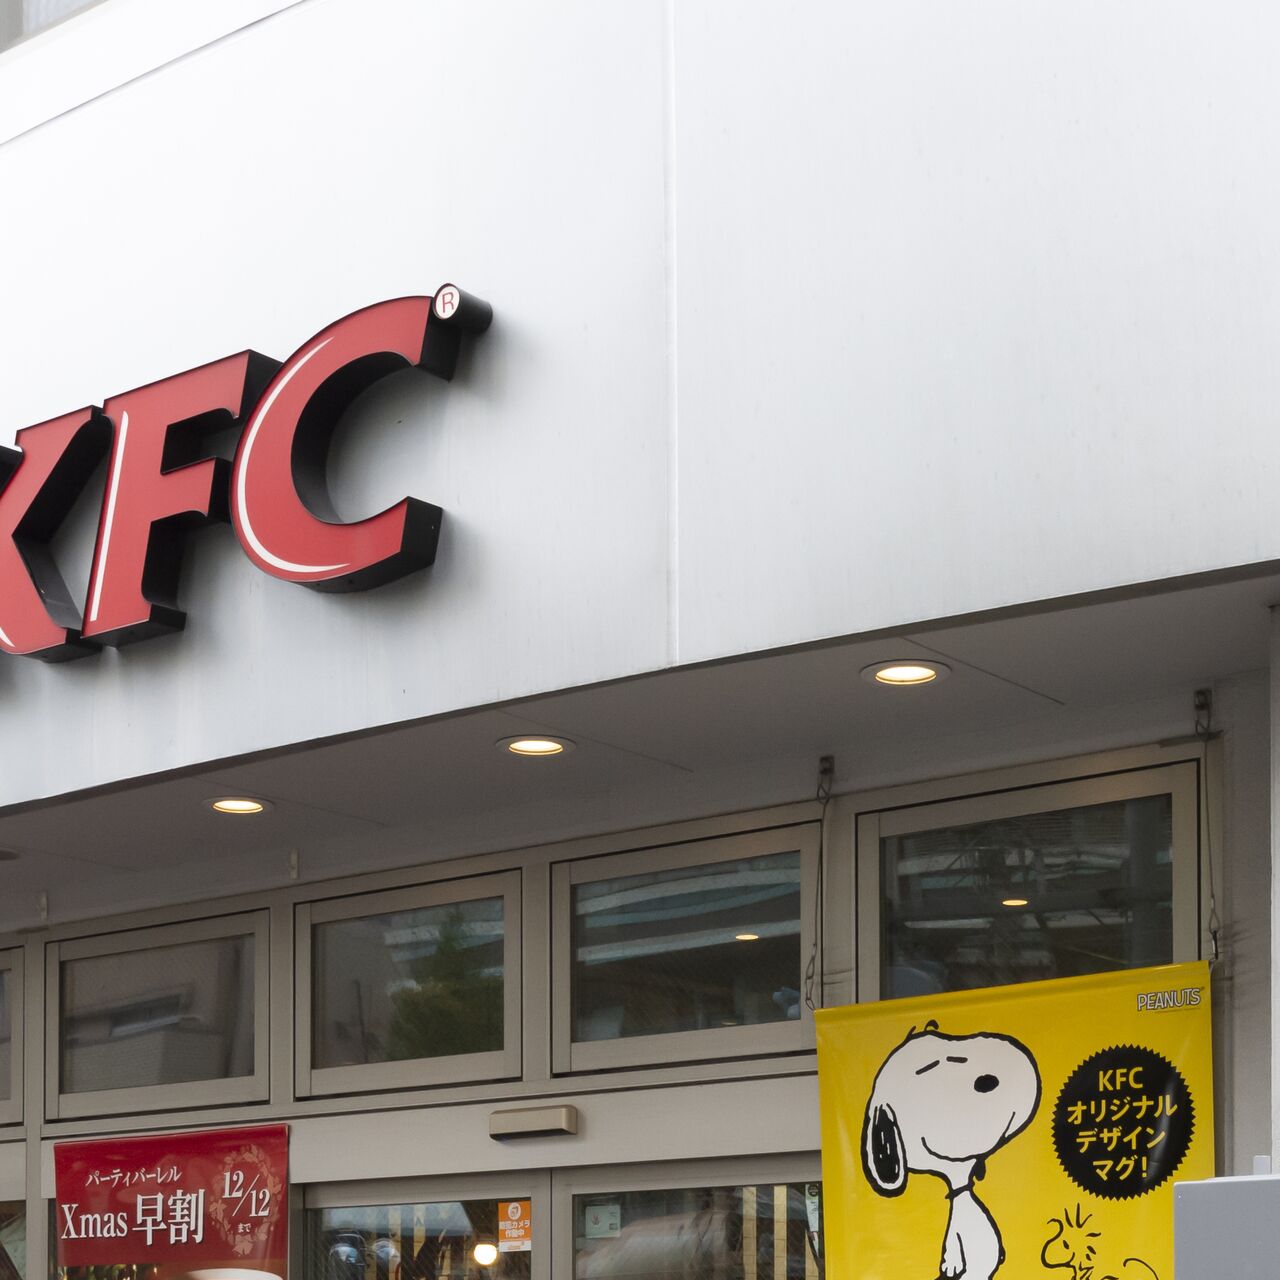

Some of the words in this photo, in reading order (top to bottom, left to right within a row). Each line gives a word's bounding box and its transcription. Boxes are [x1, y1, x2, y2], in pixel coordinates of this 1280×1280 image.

[1136, 987, 1202, 1011] PEANUTS
[1098, 1066, 1144, 1092] KFC
[1067, 1094, 1178, 1125] オリジナル
[1075, 1126, 1166, 1154] デザイン
[85, 1165, 183, 1188] パーティバーレル
[1092, 1154, 1148, 1181] マグ!
[221, 1170, 271, 1218] 12/12
[60, 1203, 128, 1240] Xmas
[131, 1188, 206, 1246] 早割
[236, 1222, 252, 1234] まで
